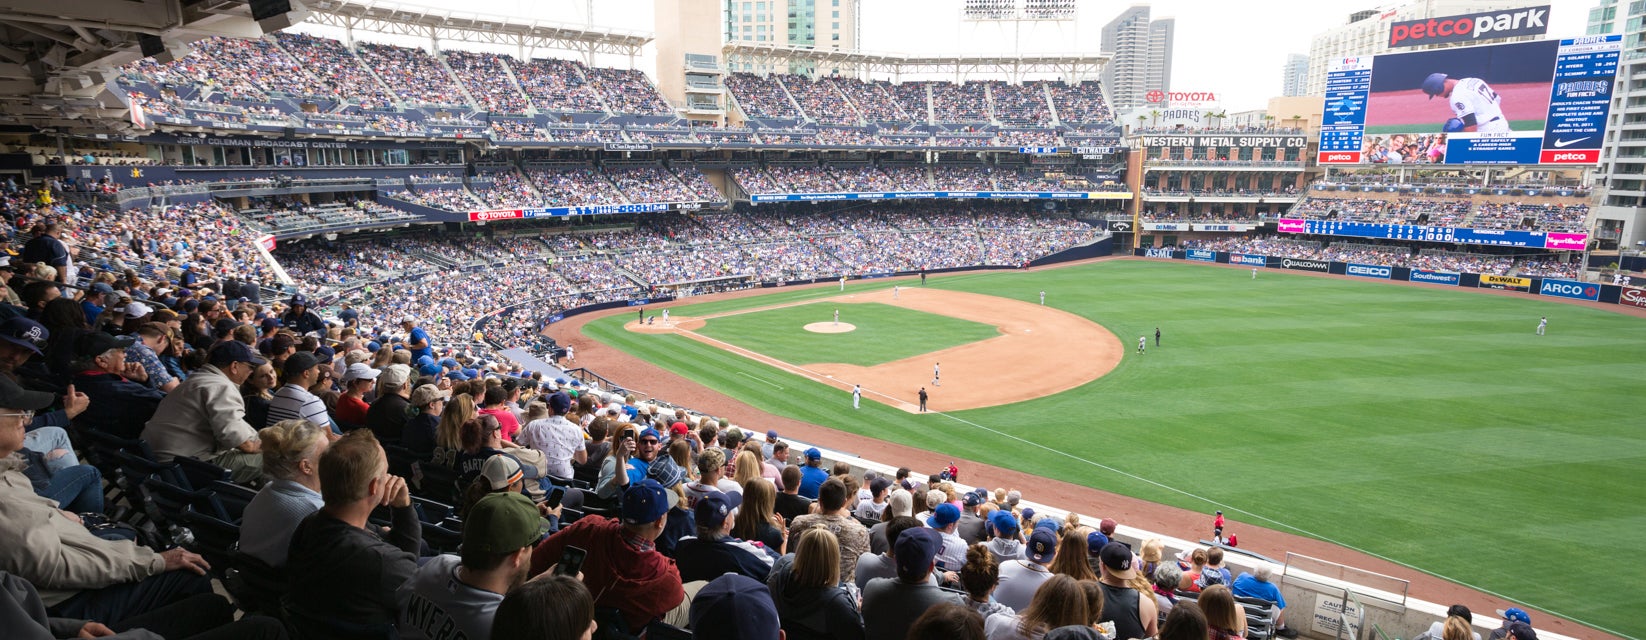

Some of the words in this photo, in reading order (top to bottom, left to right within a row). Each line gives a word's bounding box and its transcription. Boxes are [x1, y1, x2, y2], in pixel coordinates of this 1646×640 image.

[1574, 36, 1606, 45] PADRES
[1557, 80, 1608, 96] PADRES
[1168, 92, 1215, 101] TOYOTA
[1163, 109, 1200, 122] PADRES
[1143, 137, 1195, 146] WESTERN
[1200, 137, 1237, 147] METAL
[1240, 138, 1282, 147] SUPPLY
[1287, 138, 1306, 148] CO.
[1554, 153, 1586, 161] petco
[1547, 237, 1585, 246] Yogurtland
[1146, 250, 1172, 258] ASML
[1283, 258, 1327, 269] QUALCOMM
[1349, 266, 1390, 276] GEICO
[1413, 272, 1451, 281] Southwest
[1542, 282, 1582, 296] ARCO
[463, 458, 484, 473] BART
[1121, 560, 1129, 568] NY
[1324, 600, 1355, 612] CAUTON
